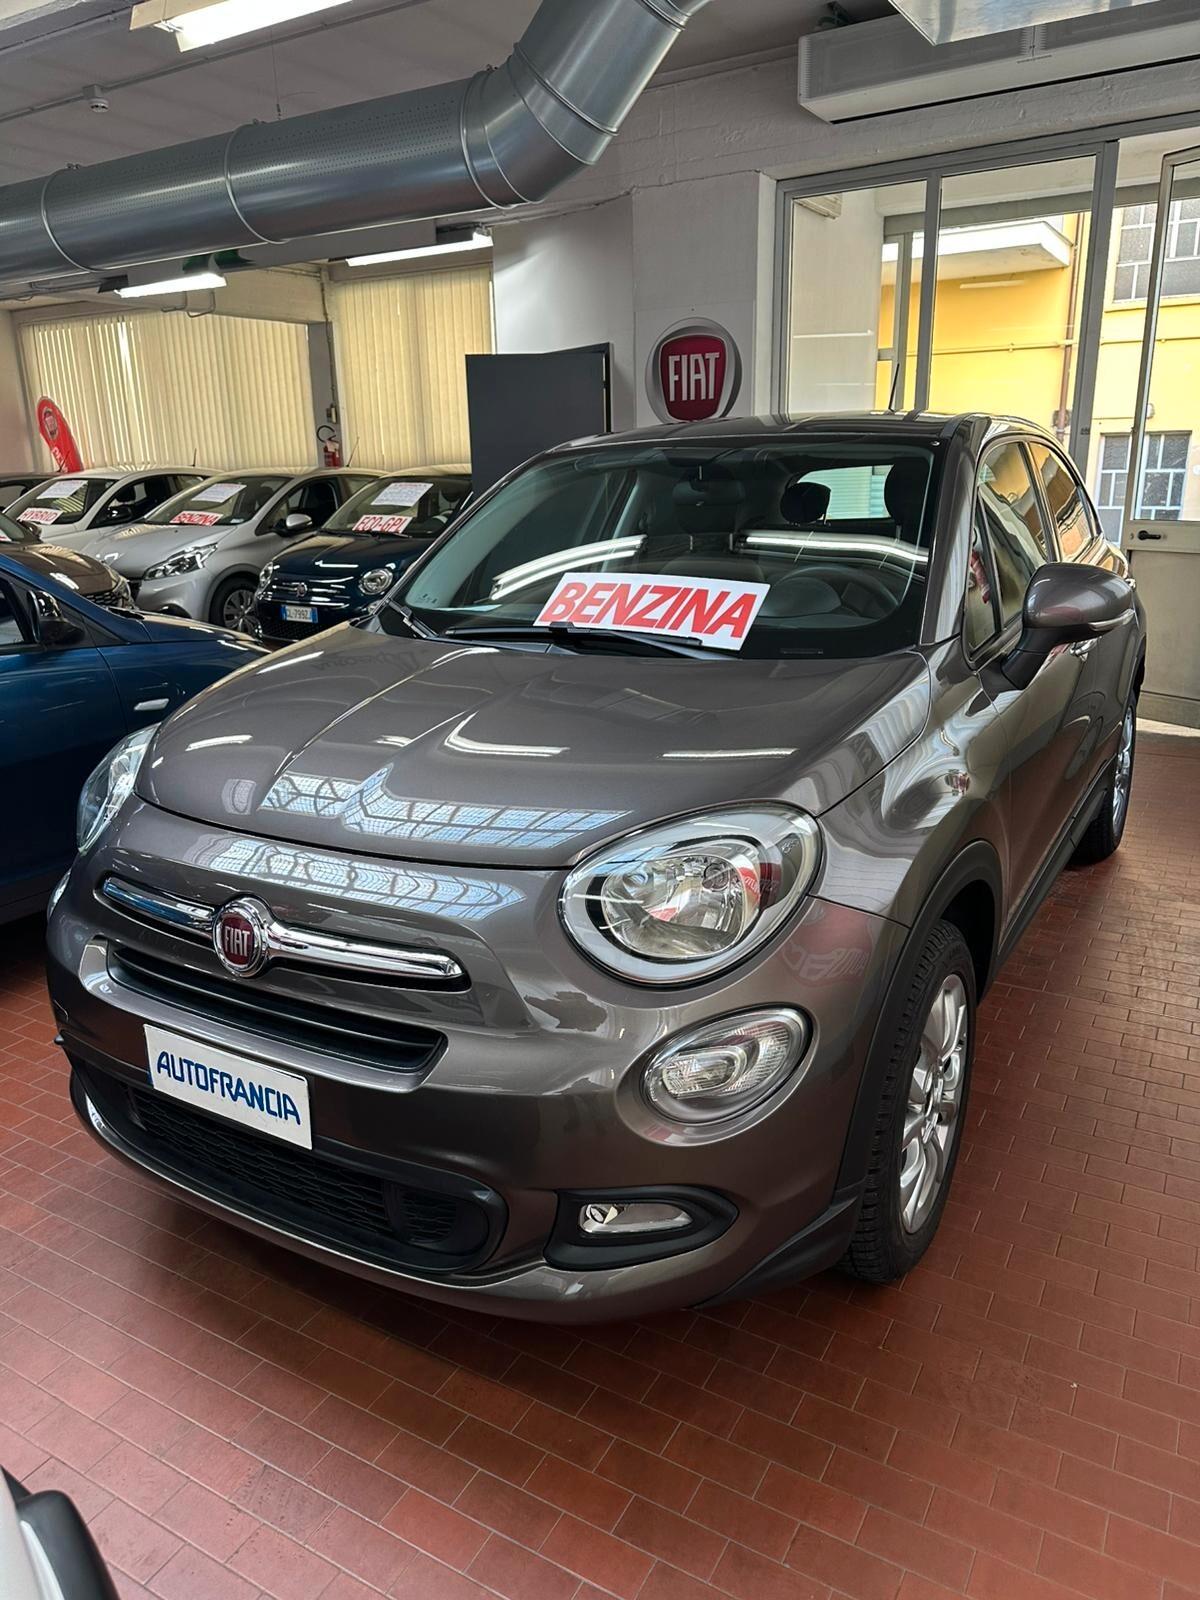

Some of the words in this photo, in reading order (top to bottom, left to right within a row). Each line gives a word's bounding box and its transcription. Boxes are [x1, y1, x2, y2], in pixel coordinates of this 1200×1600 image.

[668, 352, 720, 402] FIAT
[355, 515, 408, 533] ECO-GPL
[540, 582, 757, 638] BENZINA
[224, 925, 251, 957] FIAT
[156, 1050, 301, 1126] AUTOFRANCIA
